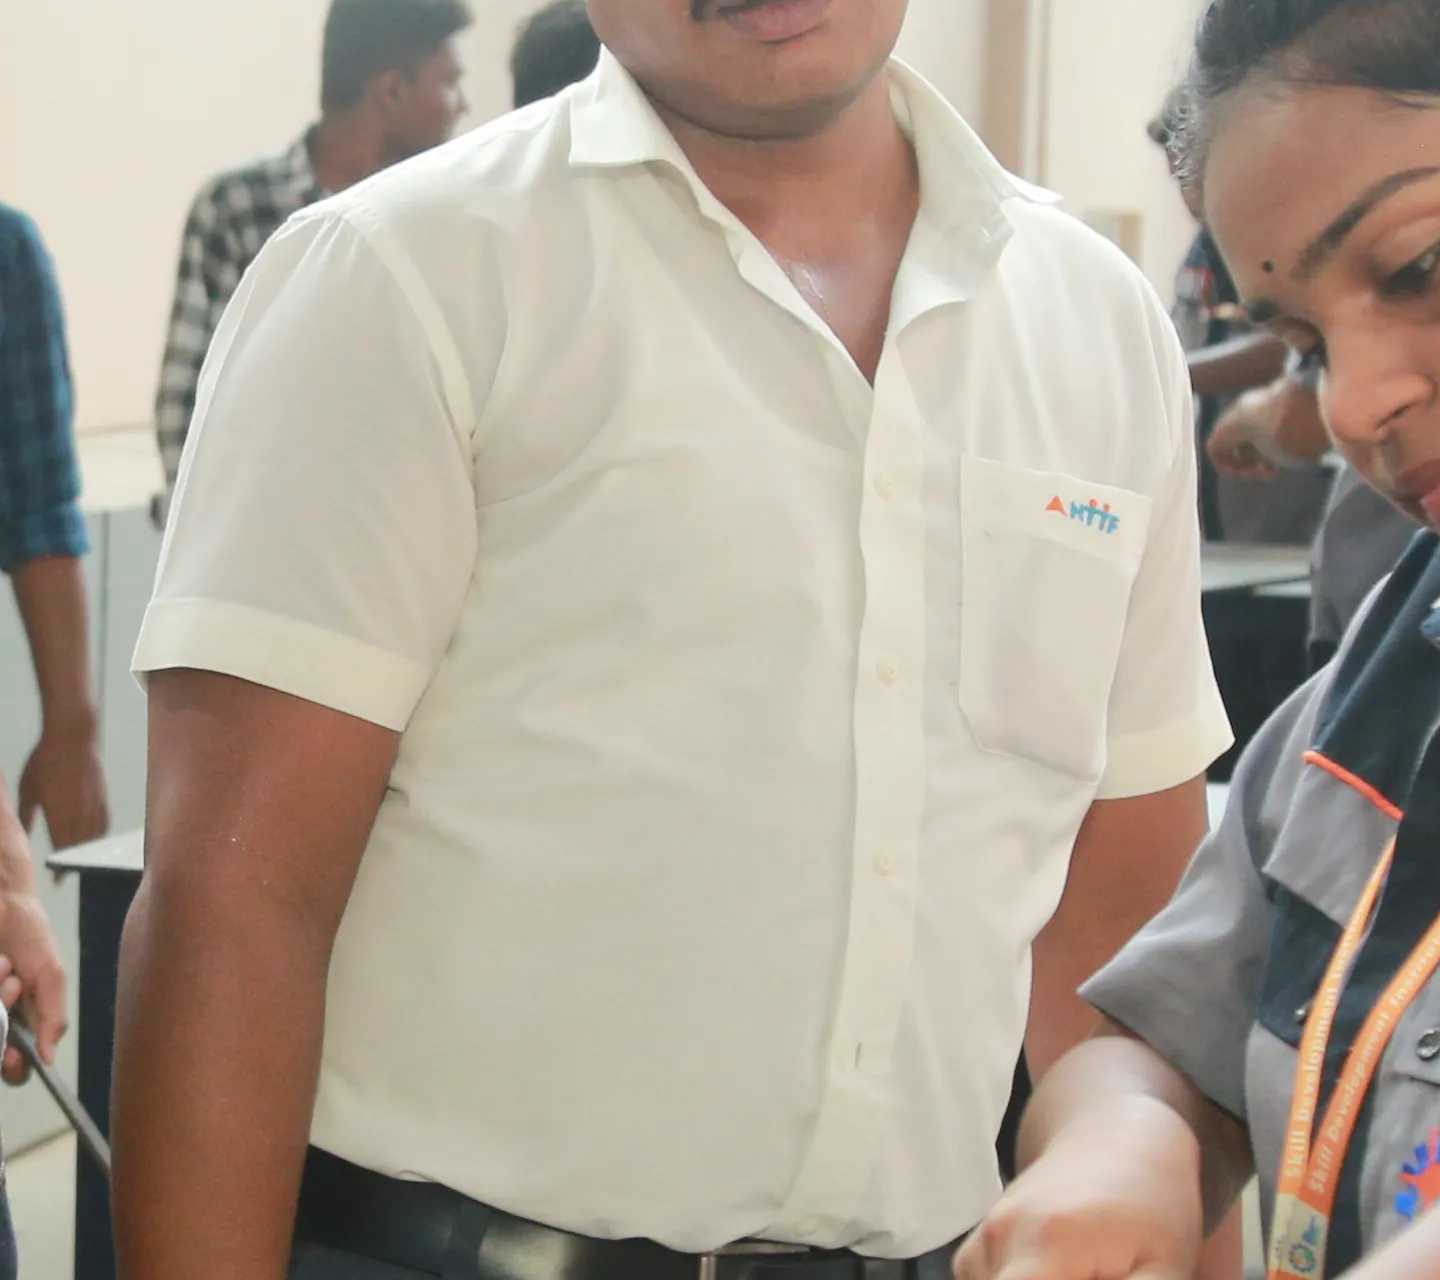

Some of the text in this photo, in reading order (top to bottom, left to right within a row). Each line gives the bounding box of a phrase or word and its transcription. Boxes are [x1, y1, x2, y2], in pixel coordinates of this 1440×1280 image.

[1287, 1130, 1306, 1178] Skill
[1297, 987, 1337, 1123] Development
[1308, 1147, 1333, 1193] Skill
[1328, 1012, 1389, 1142] Development
